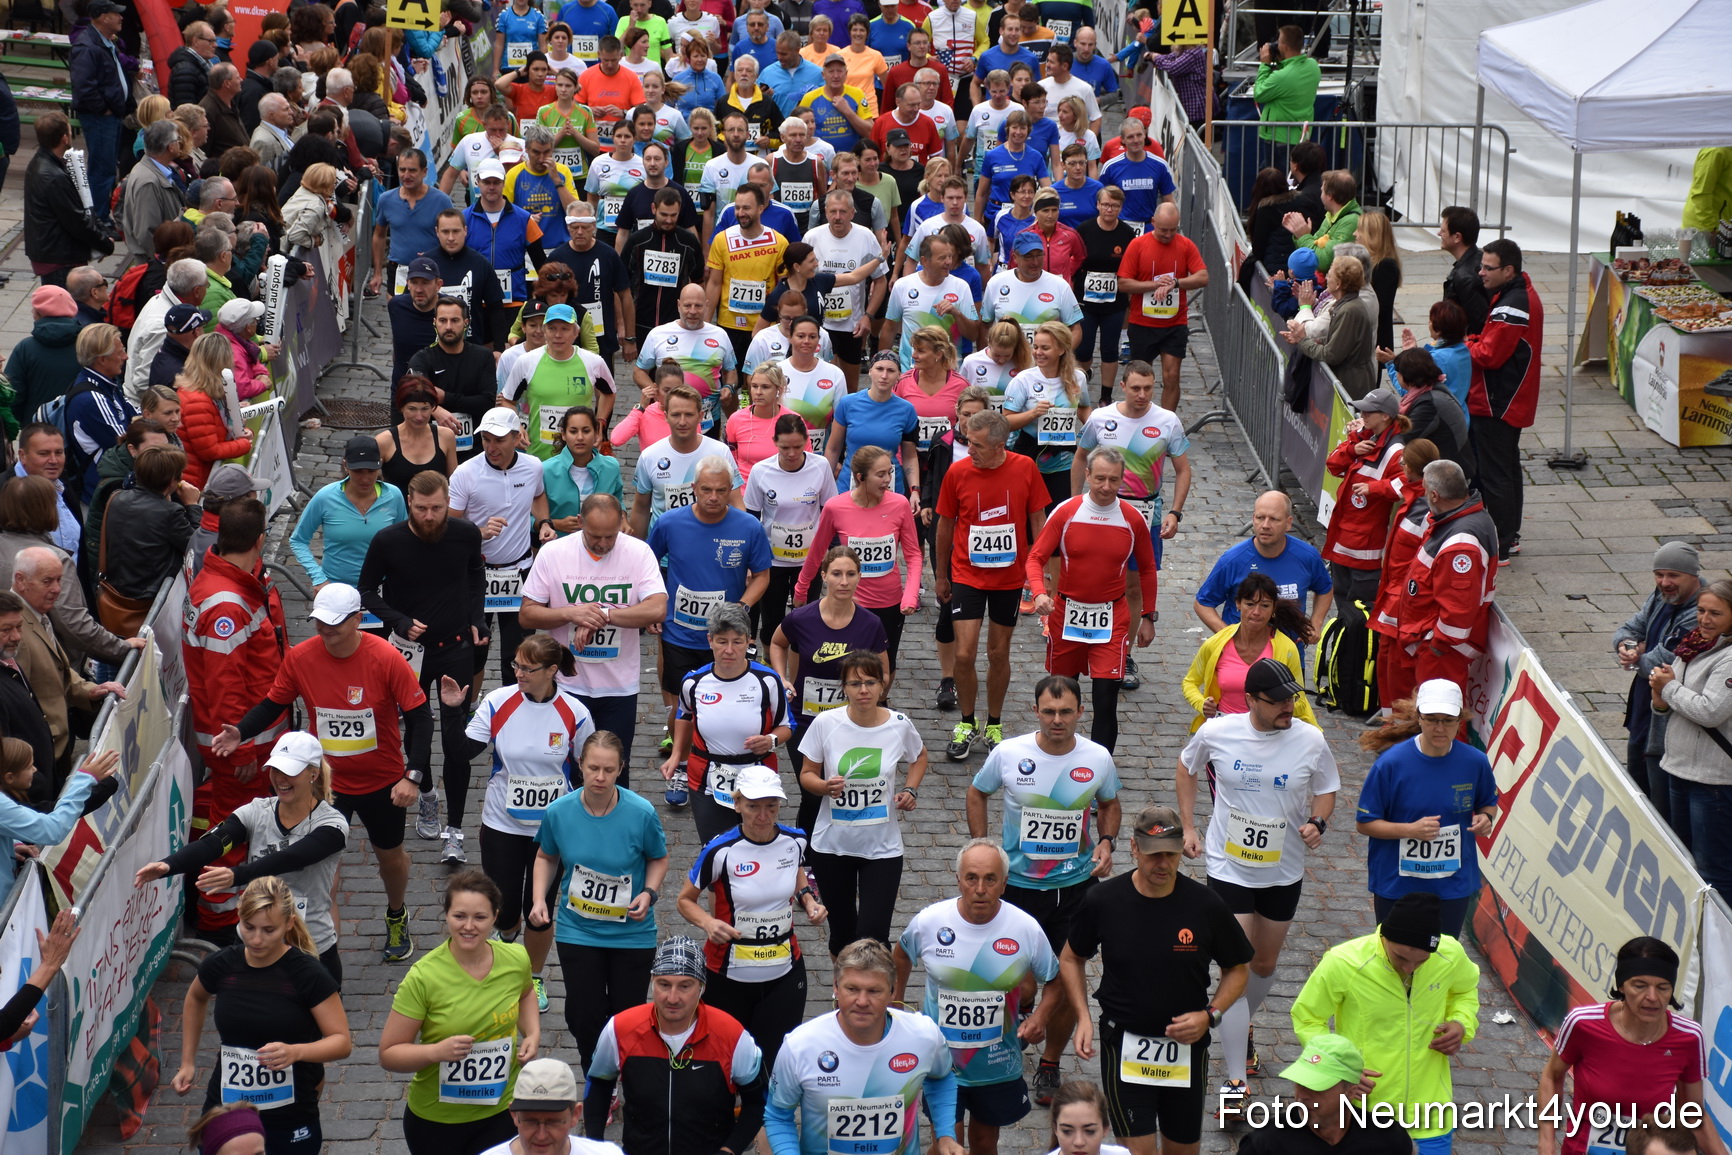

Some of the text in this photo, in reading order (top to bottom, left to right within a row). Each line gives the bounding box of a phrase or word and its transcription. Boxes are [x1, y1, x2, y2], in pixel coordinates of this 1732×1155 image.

[1173, 0, 1203, 27] A
[1049, 24, 1069, 36] 2253
[577, 41, 594, 52] 158
[512, 48, 528, 59] 234
[1121, 178, 1154, 188] HUBER
[784, 189, 811, 201] 2684
[729, 252, 751, 263] MAX
[754, 247, 779, 258] BÖGL
[646, 258, 677, 275] 2783
[822, 260, 846, 269] Allianz
[1087, 278, 1116, 292] 2340
[732, 286, 763, 302] 2719
[264, 264, 282, 337] BMW Laufsport
[1042, 416, 1074, 431] 2673
[784, 533, 804, 548] 43
[973, 534, 1013, 552] 2440
[783, 550, 804, 559] Angela
[855, 545, 892, 562] 2828
[864, 564, 882, 572] Elena
[485, 580, 520, 596] 2047
[562, 582, 633, 605] VOGT
[486, 599, 513, 607] Michael
[680, 597, 712, 617] 207
[1069, 609, 1109, 628] 2416
[1082, 630, 1093, 638] Ivo
[819, 641, 848, 655] RUN
[701, 692, 716, 701] tkn
[318, 712, 334, 720] PARTL
[329, 720, 365, 738] 529
[1016, 776, 1036, 784] PARTL
[1073, 769, 1093, 780] Hervis
[509, 778, 556, 788] PARTL Neumarkt
[512, 786, 560, 807] 3094
[835, 786, 883, 808] 3012
[1023, 811, 1074, 821] PARTL Neumarkt
[1230, 813, 1278, 829] PARTL Neumarkt
[1026, 820, 1077, 841] 2756
[1242, 827, 1269, 849] 36
[1036, 843, 1065, 854] Marcus
[1406, 838, 1456, 859] 2075
[1241, 849, 1264, 861] Heiko
[575, 867, 596, 879] PARTL
[735, 863, 753, 872] tkn
[1414, 863, 1445, 873] Dagmar
[581, 878, 619, 904] 301
[581, 902, 611, 916] Kerstin
[737, 913, 786, 924] PARTL Neumarkt
[755, 924, 780, 940] 63
[995, 940, 1018, 952] Hervis
[754, 949, 777, 959] Heide
[939, 993, 994, 1003] PARTL Neumarkt
[945, 1003, 999, 1027] 2687
[960, 1030, 982, 1042] Gerd
[222, 1051, 243, 1060] PARTL
[1137, 1037, 1179, 1063] 270
[447, 1055, 506, 1083] 2622
[892, 1057, 916, 1069] Hervis
[1141, 1066, 1171, 1078] Walter
[239, 1091, 274, 1102] Jasmin
[458, 1086, 495, 1097] Henrike
[829, 1102, 893, 1112] PARTL Neumarkt
[835, 1111, 898, 1137] 2212
[854, 1142, 878, 1153] Felix
